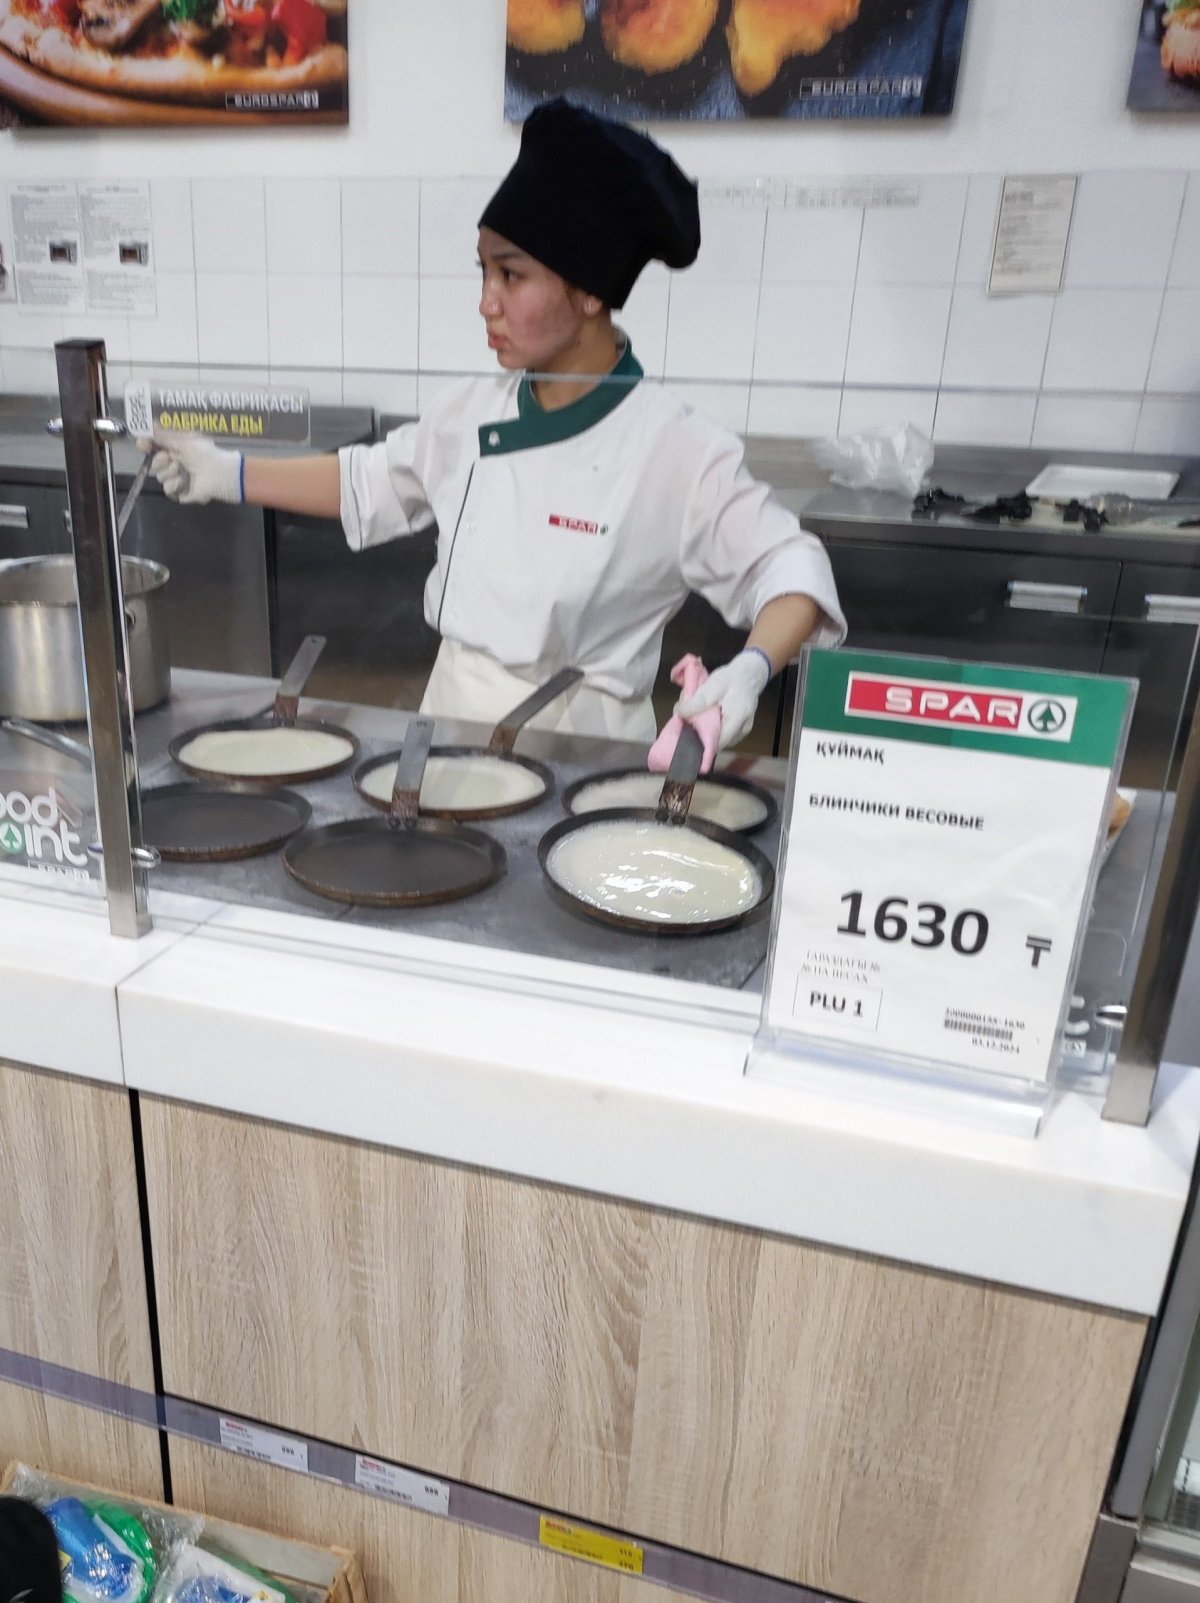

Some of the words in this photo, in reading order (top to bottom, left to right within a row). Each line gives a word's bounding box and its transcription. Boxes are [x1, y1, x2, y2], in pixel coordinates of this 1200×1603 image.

[159, 388, 209, 411] ТАМАҚ
[159, 411, 229, 434] ФАБРИКА
[884, 686, 1020, 726] SPAR
[809, 793, 901, 819] БЛИНЧИКИ
[904, 806, 985, 831] ВЕСОВЫЕ
[837, 889, 989, 957] 1630
[809, 990, 846, 1013] PLU
[853, 999, 864, 1018] 1
